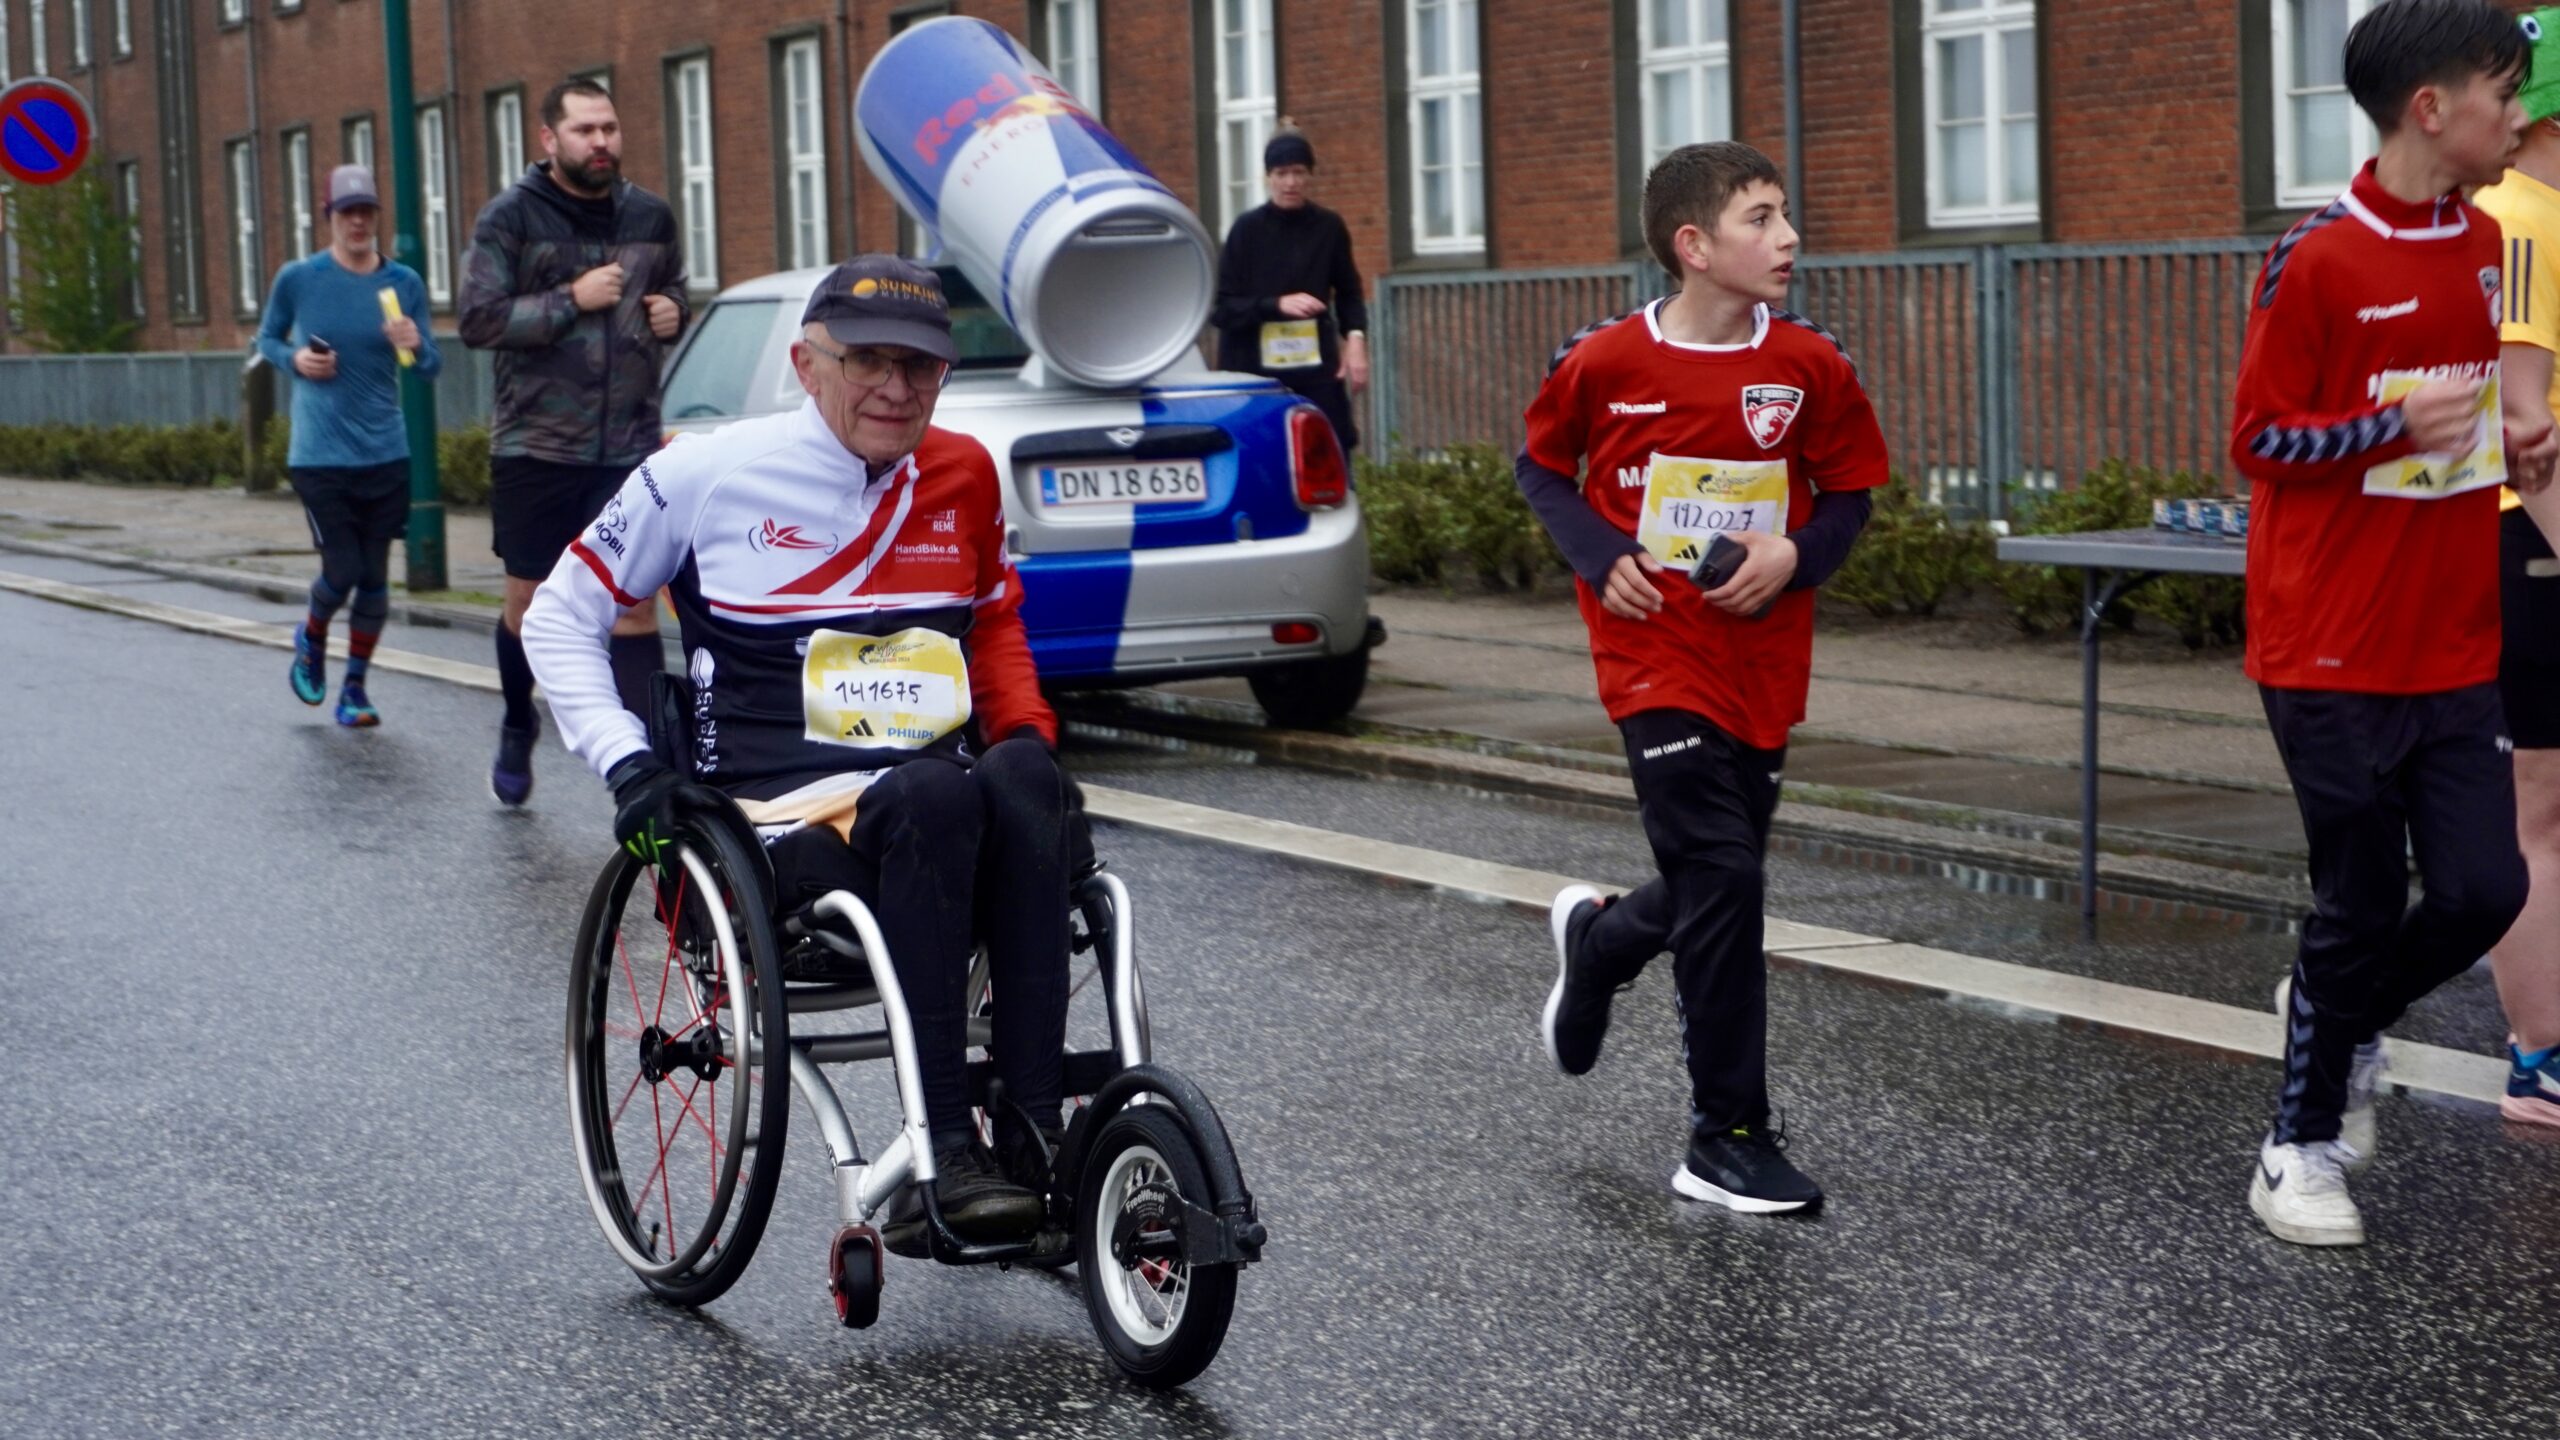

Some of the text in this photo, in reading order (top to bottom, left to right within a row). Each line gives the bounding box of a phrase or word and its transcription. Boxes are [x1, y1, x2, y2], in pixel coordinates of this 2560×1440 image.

[914, 73, 1021, 168] Red
[880, 277, 939, 303] SUNRISE
[1620, 400, 1667, 414] hummel
[1061, 465, 1200, 499] DN 18 636
[946, 509, 956, 520] XT
[933, 520, 956, 532] REME
[895, 543, 960, 555] HandBike.dk
[835, 681, 922, 704] 141675
[887, 727, 935, 741] PHILIPS
[1125, 1188, 1166, 1214] FreeWheel
